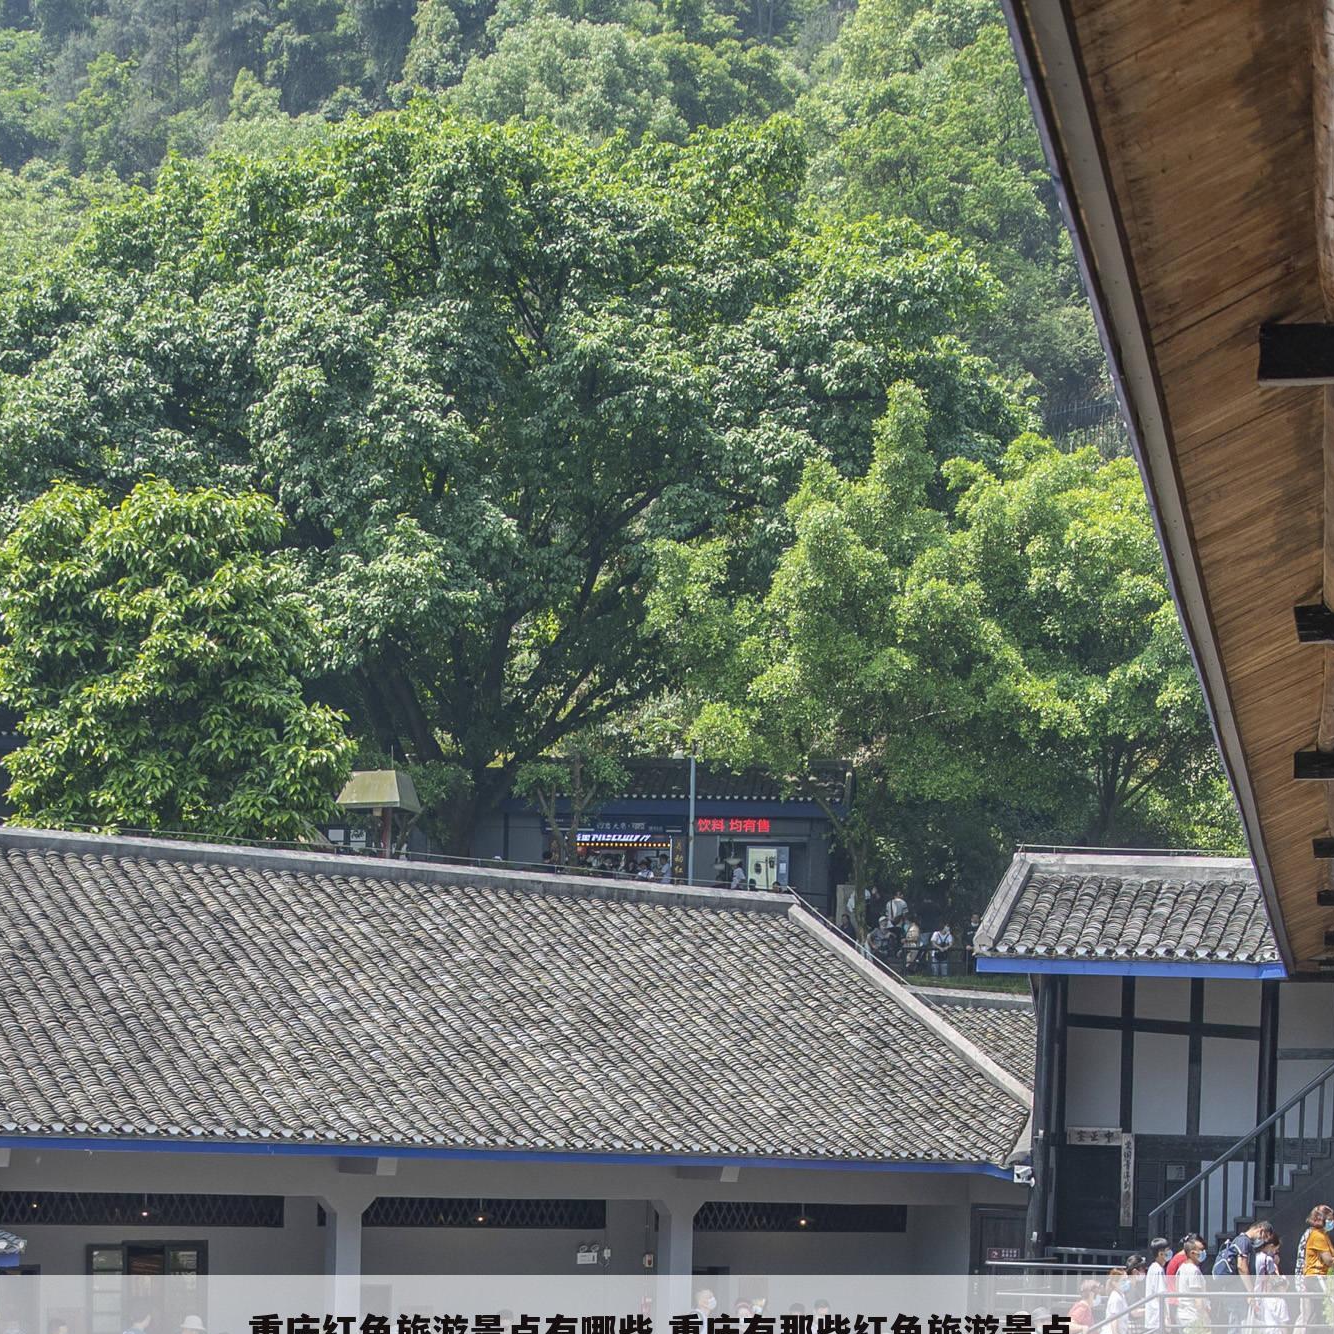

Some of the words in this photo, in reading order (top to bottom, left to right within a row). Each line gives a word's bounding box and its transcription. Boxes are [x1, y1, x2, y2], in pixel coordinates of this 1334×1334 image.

[697, 817, 726, 833] 饮料
[728, 817, 771, 833] 均有售
